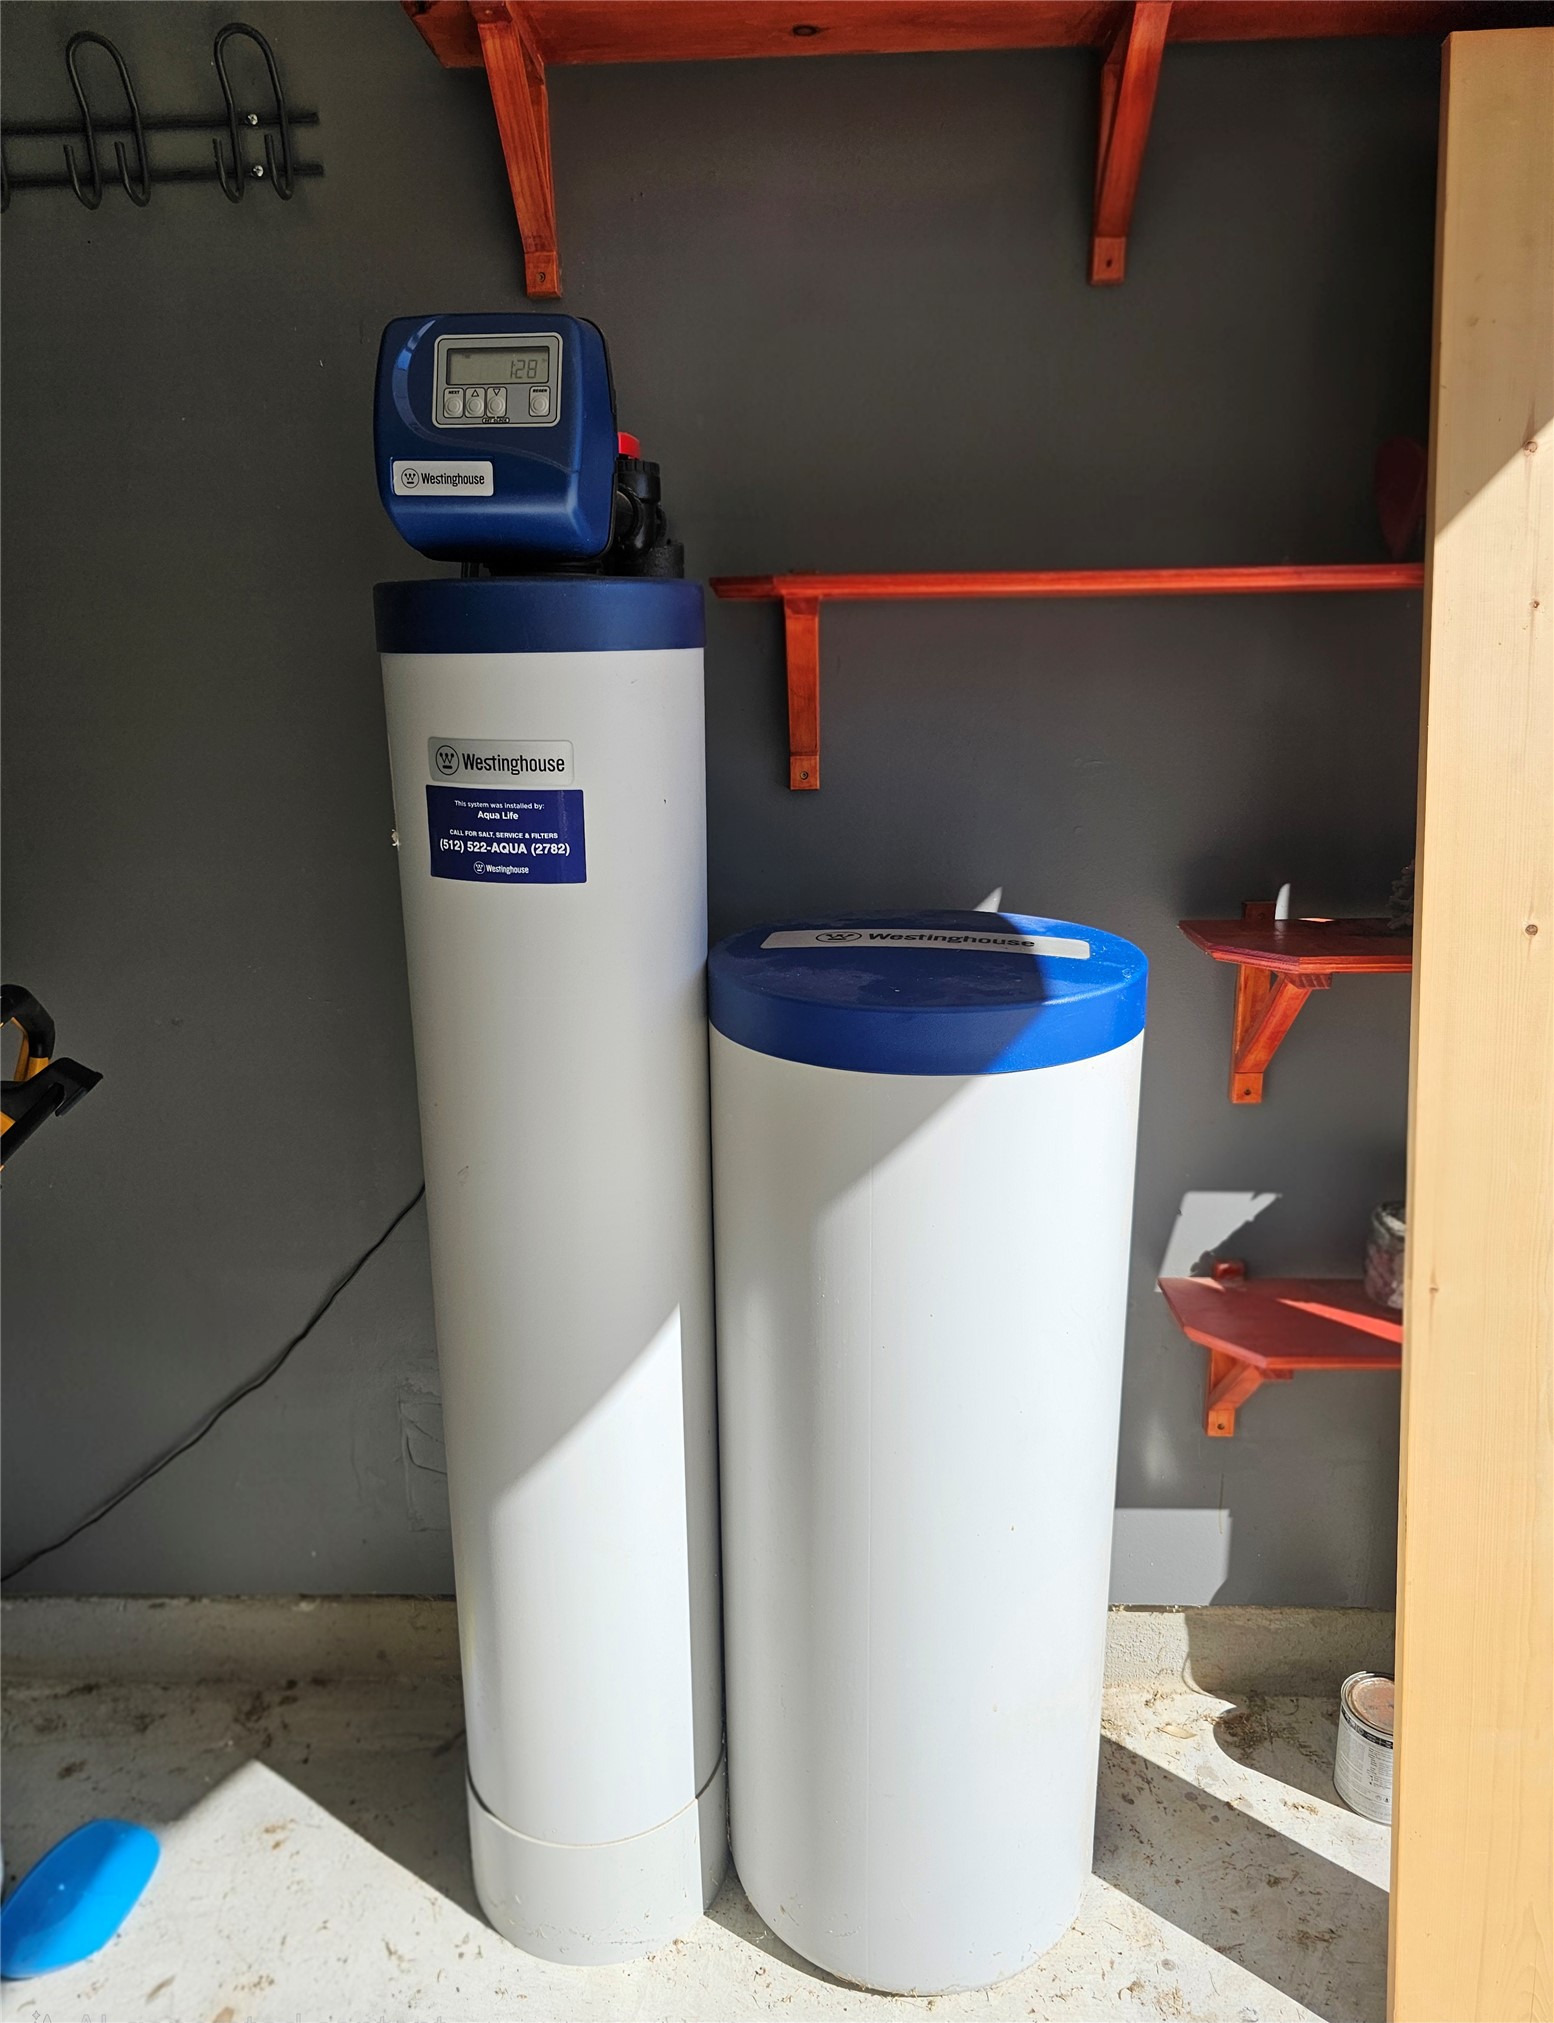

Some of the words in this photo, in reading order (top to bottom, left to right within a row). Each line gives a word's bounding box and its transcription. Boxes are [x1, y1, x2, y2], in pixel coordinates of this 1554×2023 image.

[421, 472, 485, 487] Westinghouse
[462, 753, 565, 776] Westinghouse
[467, 801, 489, 809] system
[504, 802, 533, 810] installed
[533, 803, 545, 811] by:
[477, 811, 500, 820] Aqua
[502, 811, 519, 820] Life
[478, 831, 495, 839] SALT,
[440, 838, 465, 854] (512)
[467, 841, 527, 855] 522-AQUA
[530, 843, 570, 857] (2782)
[486, 864, 529, 875] Westinghouse
[868, 932, 1035, 947] Westinghouse
